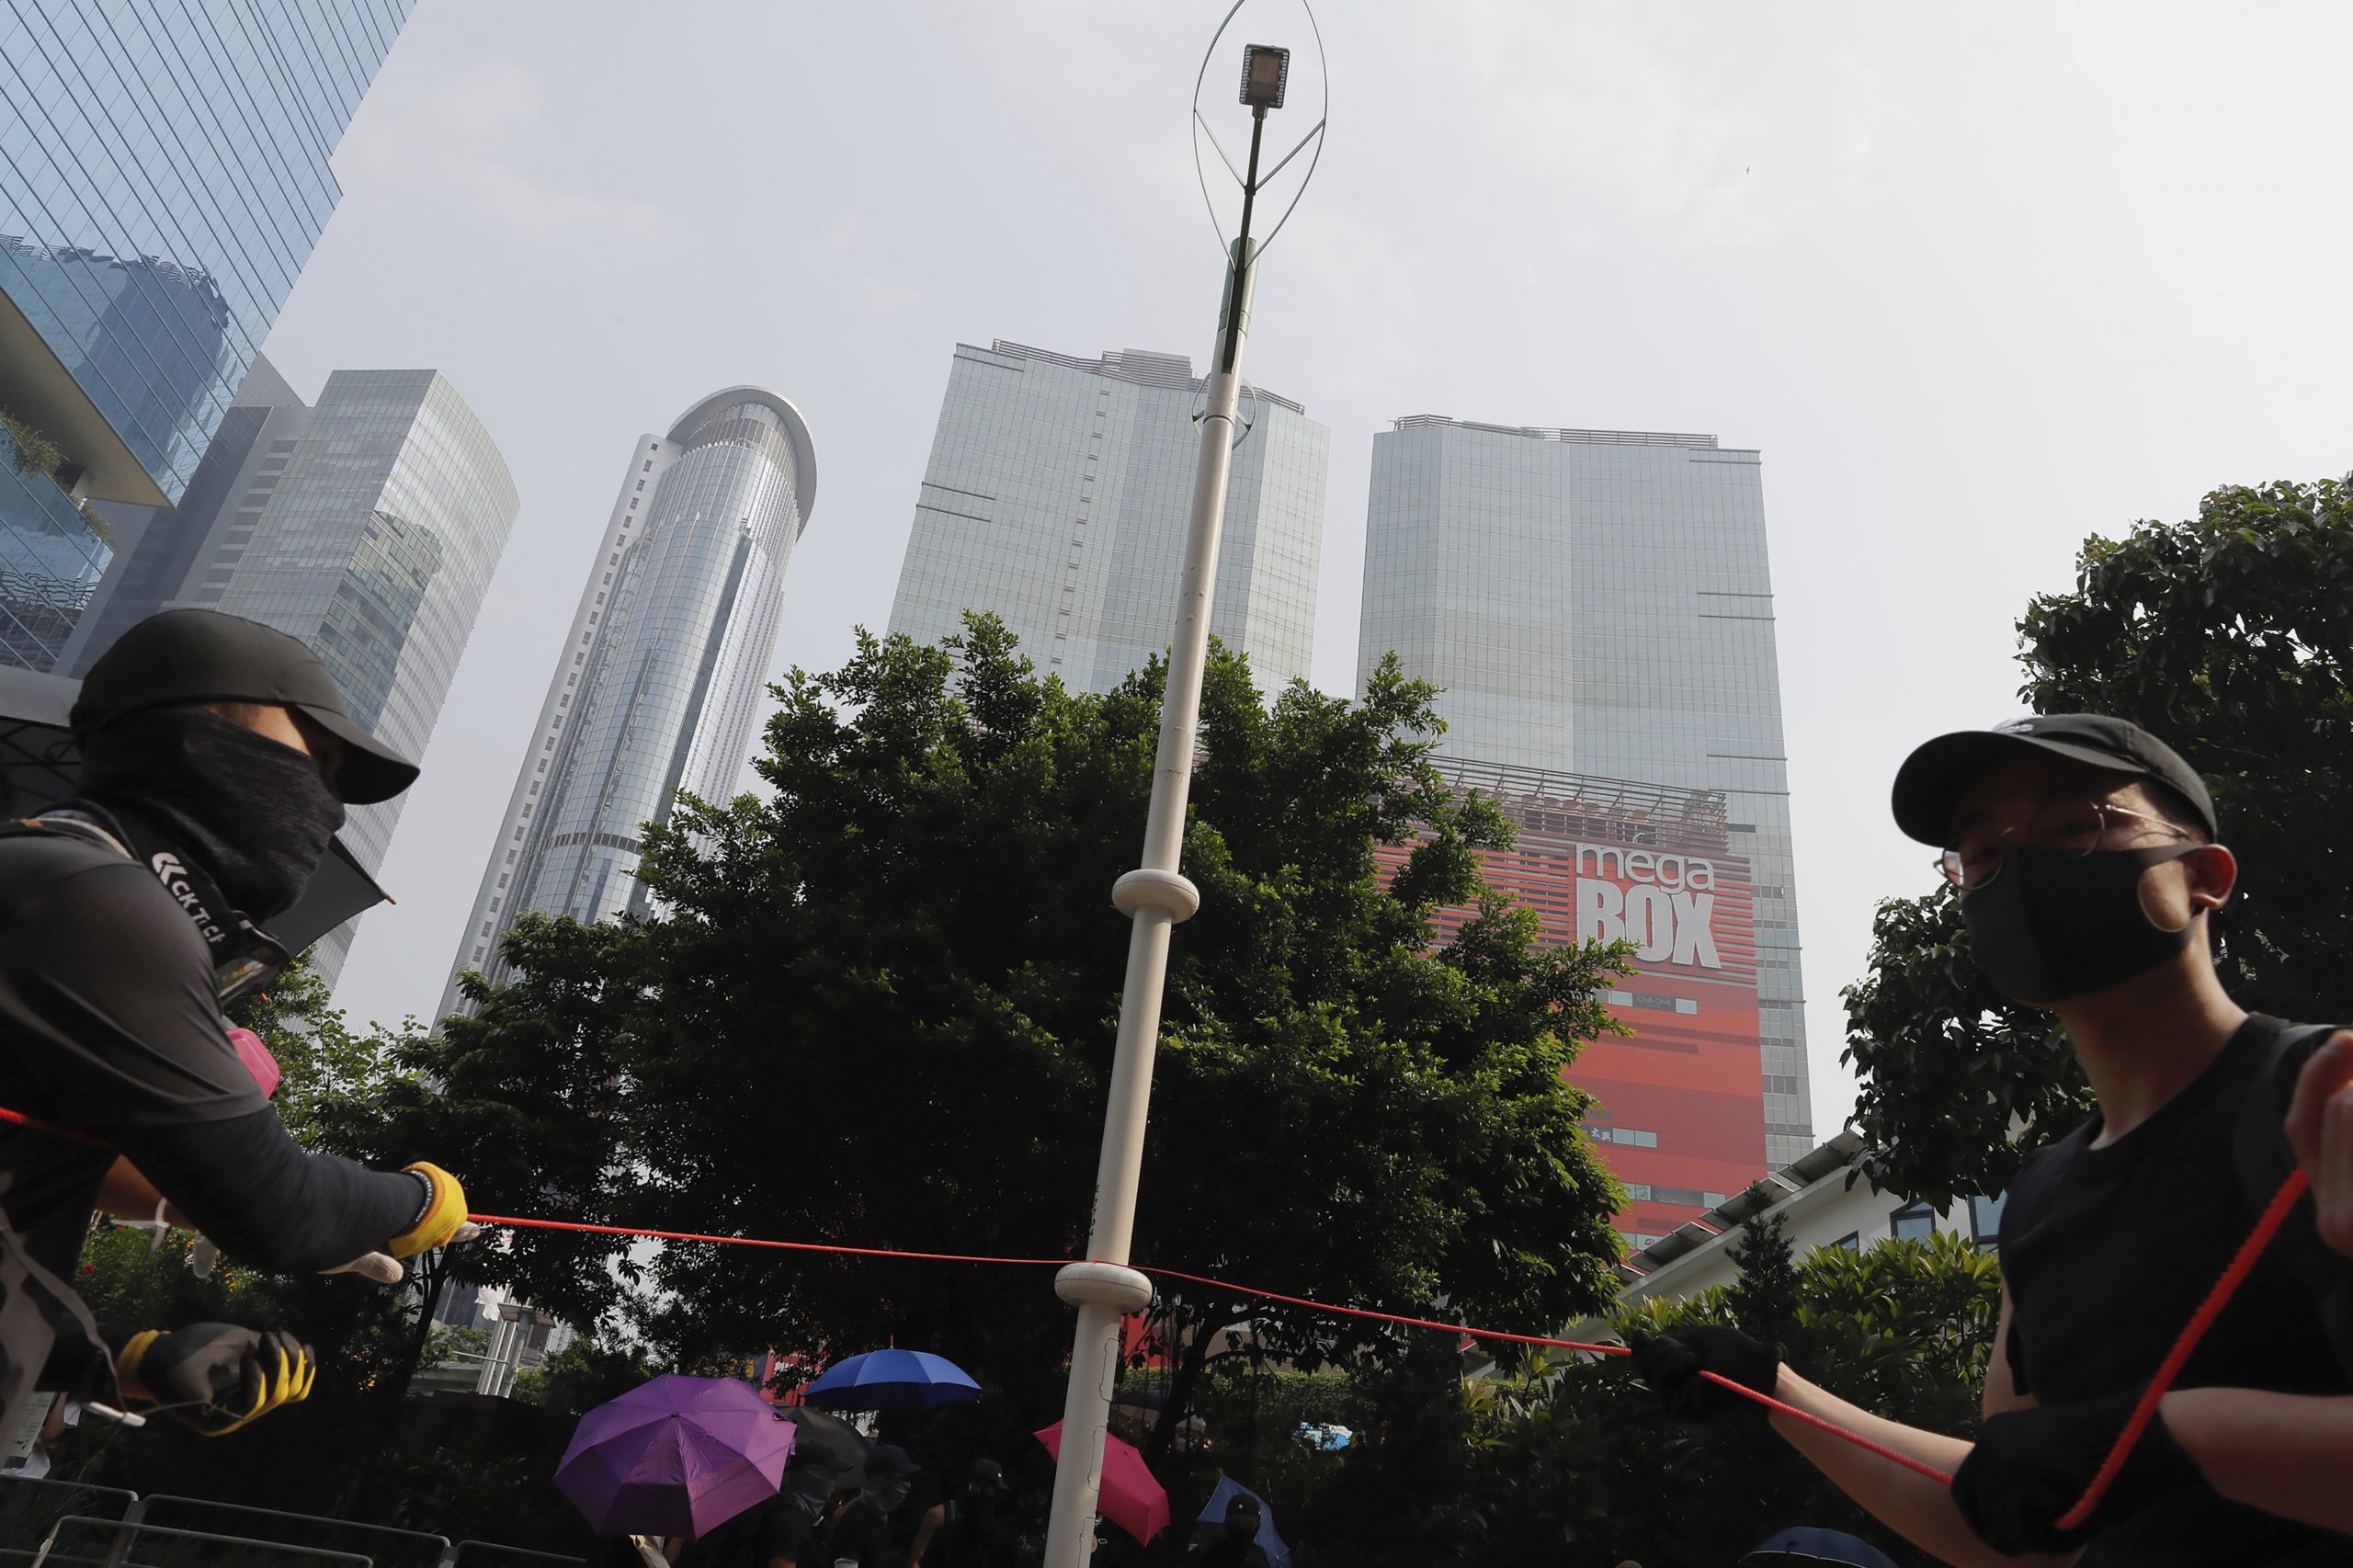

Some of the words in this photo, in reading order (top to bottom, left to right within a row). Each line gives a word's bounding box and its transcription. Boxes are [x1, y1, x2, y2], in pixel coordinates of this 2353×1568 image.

[1575, 842, 1715, 894] mega
[171, 880, 199, 910] CK
[1575, 877, 1722, 970] BOX
